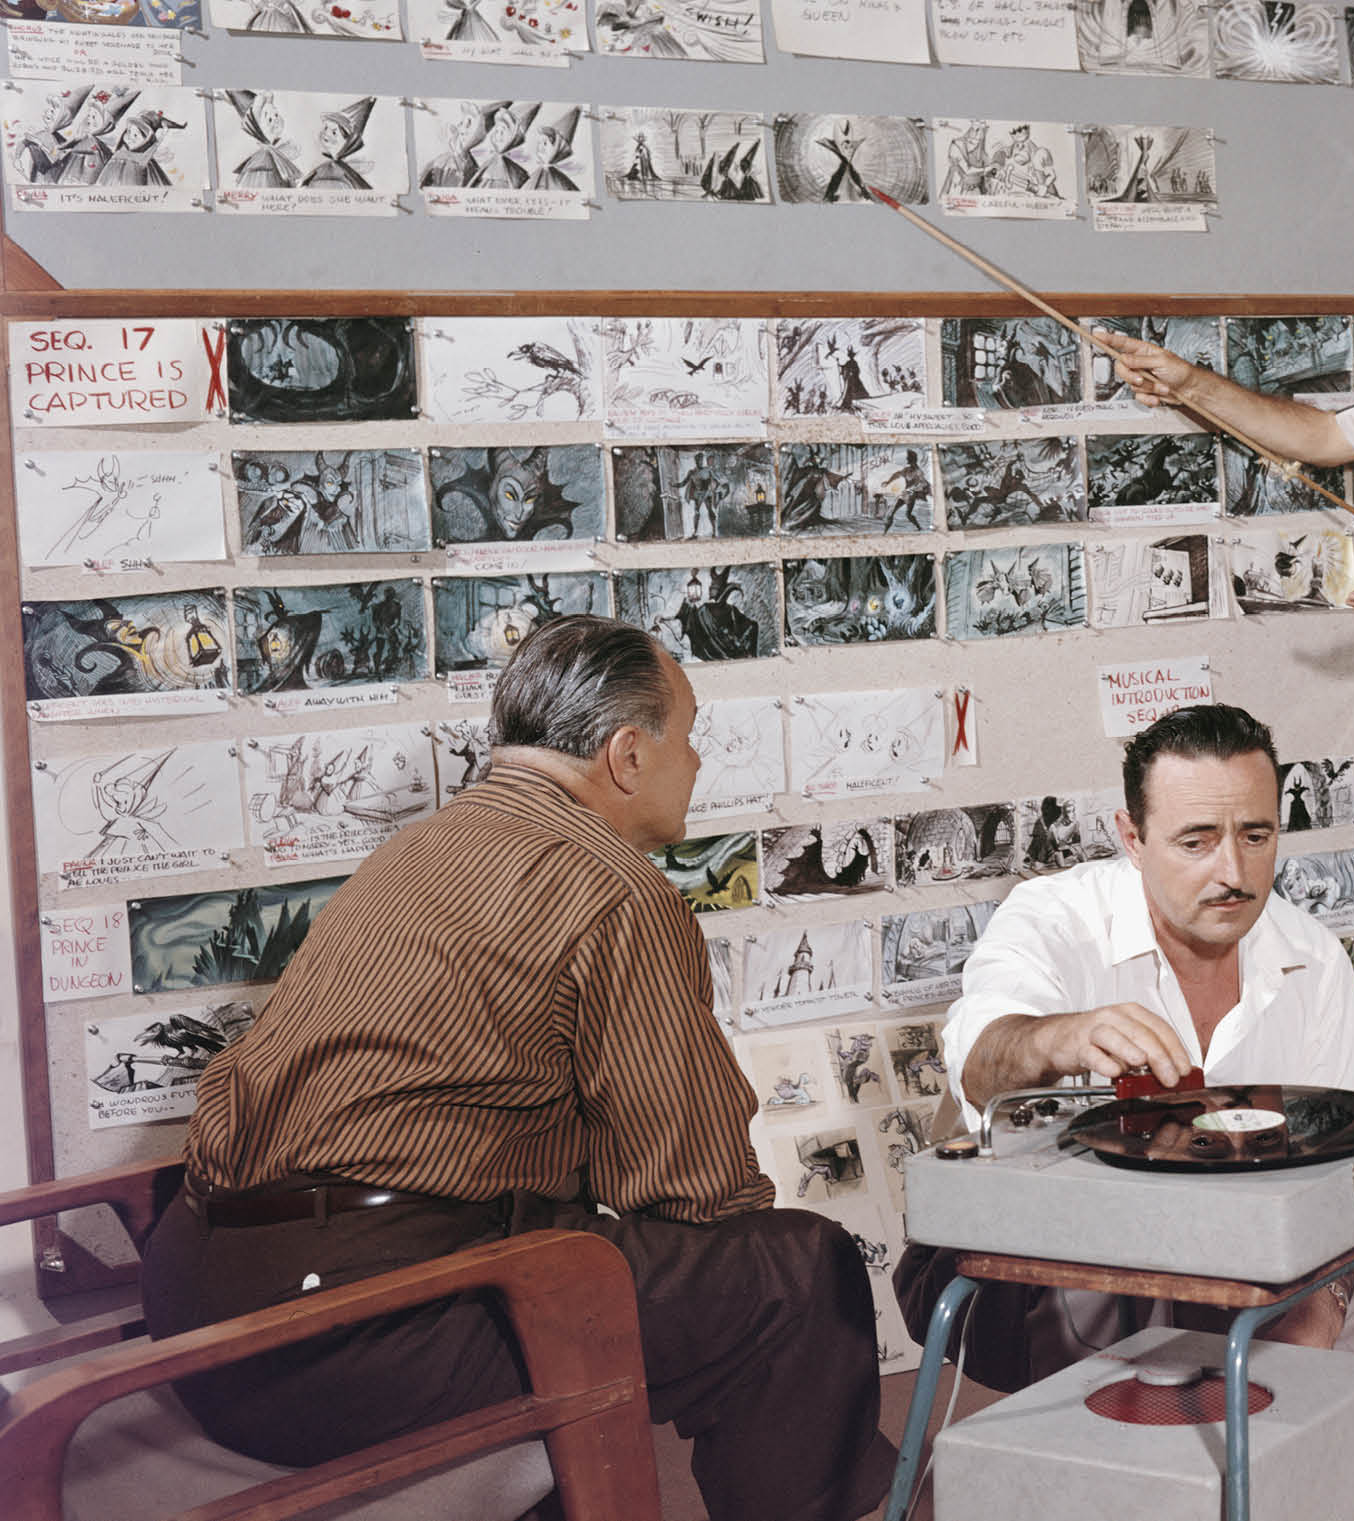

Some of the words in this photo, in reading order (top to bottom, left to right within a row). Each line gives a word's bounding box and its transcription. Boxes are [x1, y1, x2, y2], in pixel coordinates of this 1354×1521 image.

[802, 9, 850, 23] QUEEN
[60, 193, 83, 204] IT'S
[29, 330, 94, 352] SEQ.
[121, 327, 156, 351] 17
[25, 360, 138, 385] PRINCE
[158, 359, 184, 382] IS
[29, 389, 188, 413] CAPTURED
[1107, 668, 1182, 689] MUSICAL
[1111, 685, 1210, 706] INTRODUCTION
[107, 856, 136, 866] JUST
[137, 853, 170, 864] CAN'T
[202, 849, 216, 857] TO
[92, 867, 110, 877] THE
[110, 863, 151, 875] PRINCE
[152, 862, 169, 872] THE
[49, 917, 94, 935] SEQ
[104, 911, 124, 929] 18
[52, 936, 108, 955] PRINCE
[71, 954, 89, 969] IN
[49, 970, 123, 992] DUNGEON
[109, 1094, 168, 1108] WONDROUS
[98, 1107, 137, 1119] BEFORE
